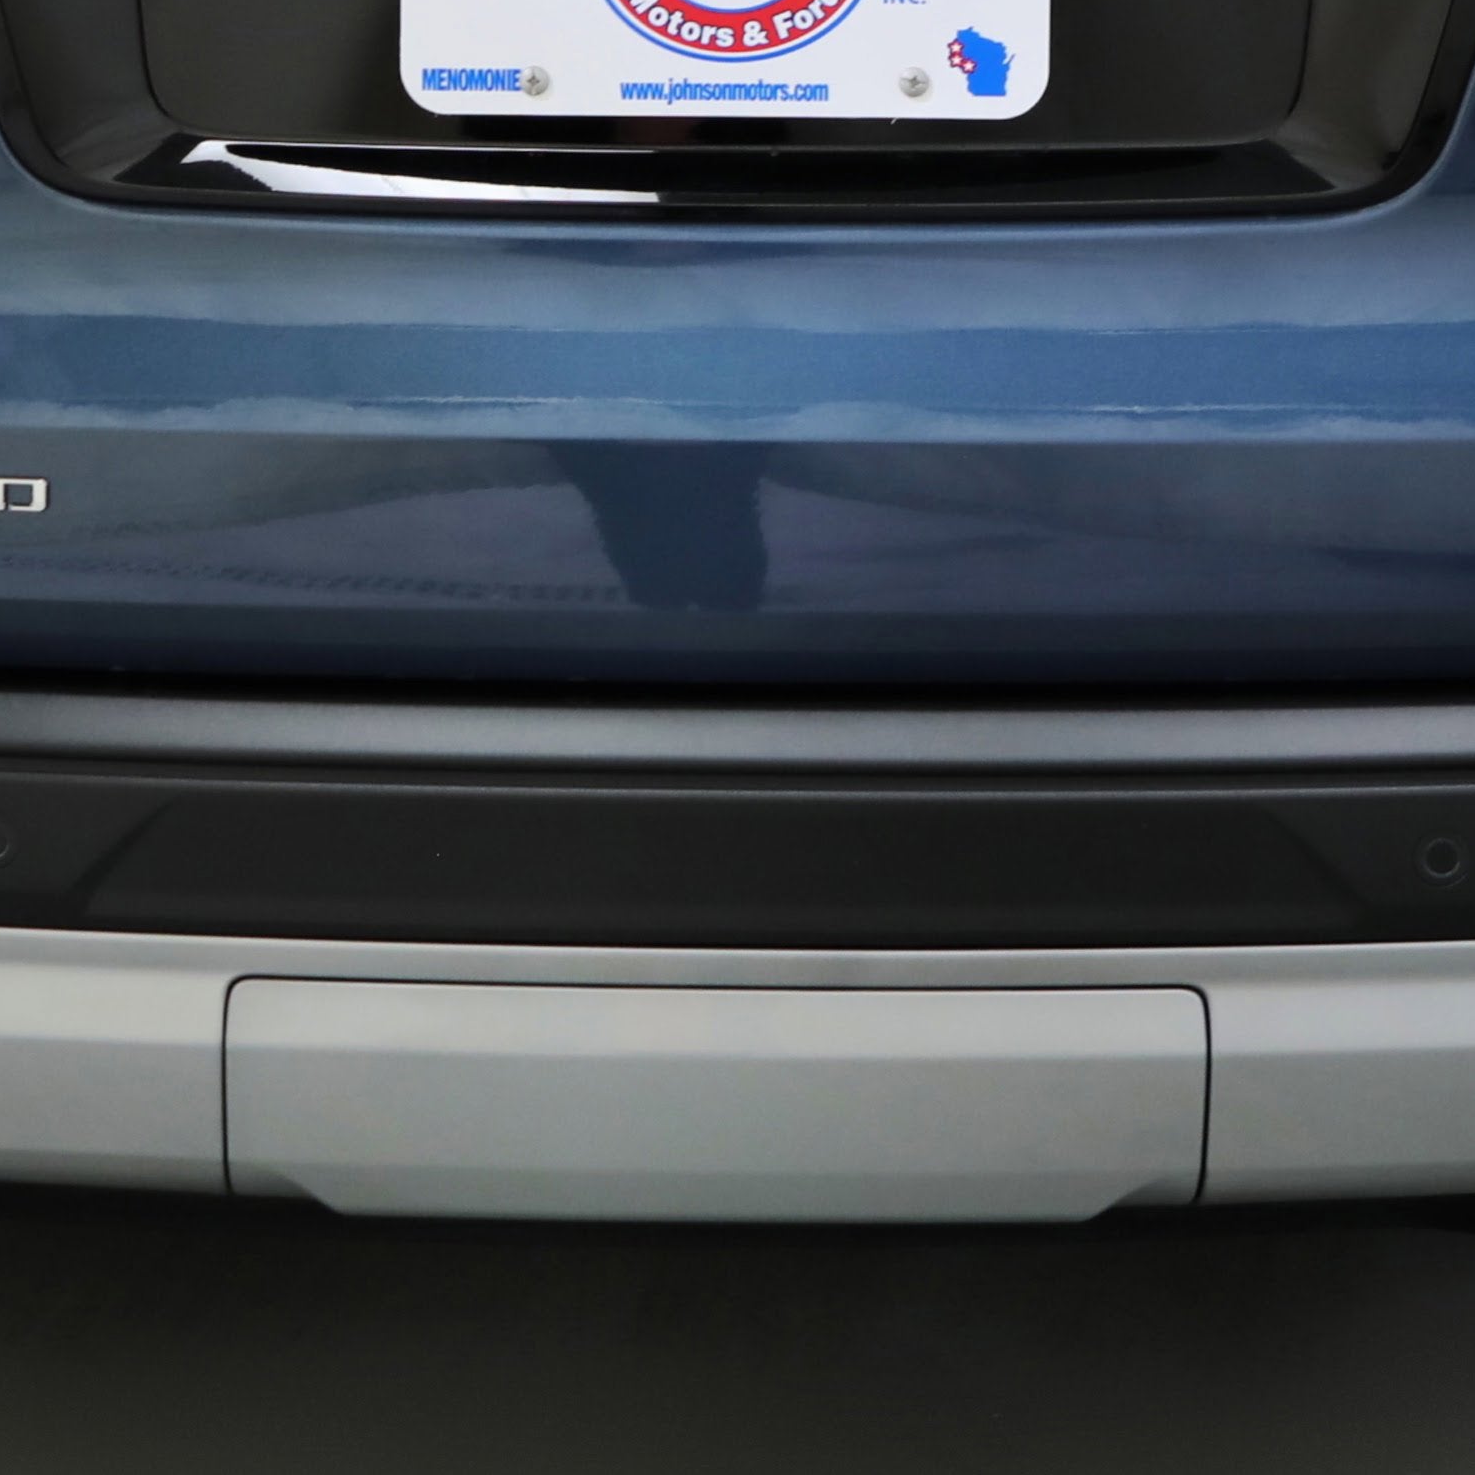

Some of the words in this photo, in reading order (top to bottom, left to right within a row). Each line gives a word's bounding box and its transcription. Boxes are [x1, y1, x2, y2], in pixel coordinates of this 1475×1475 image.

[743, 21, 769, 47] &
[422, 68, 521, 91] MENOMONIE
[620, 78, 829, 105] www.johnsonmotors.com
